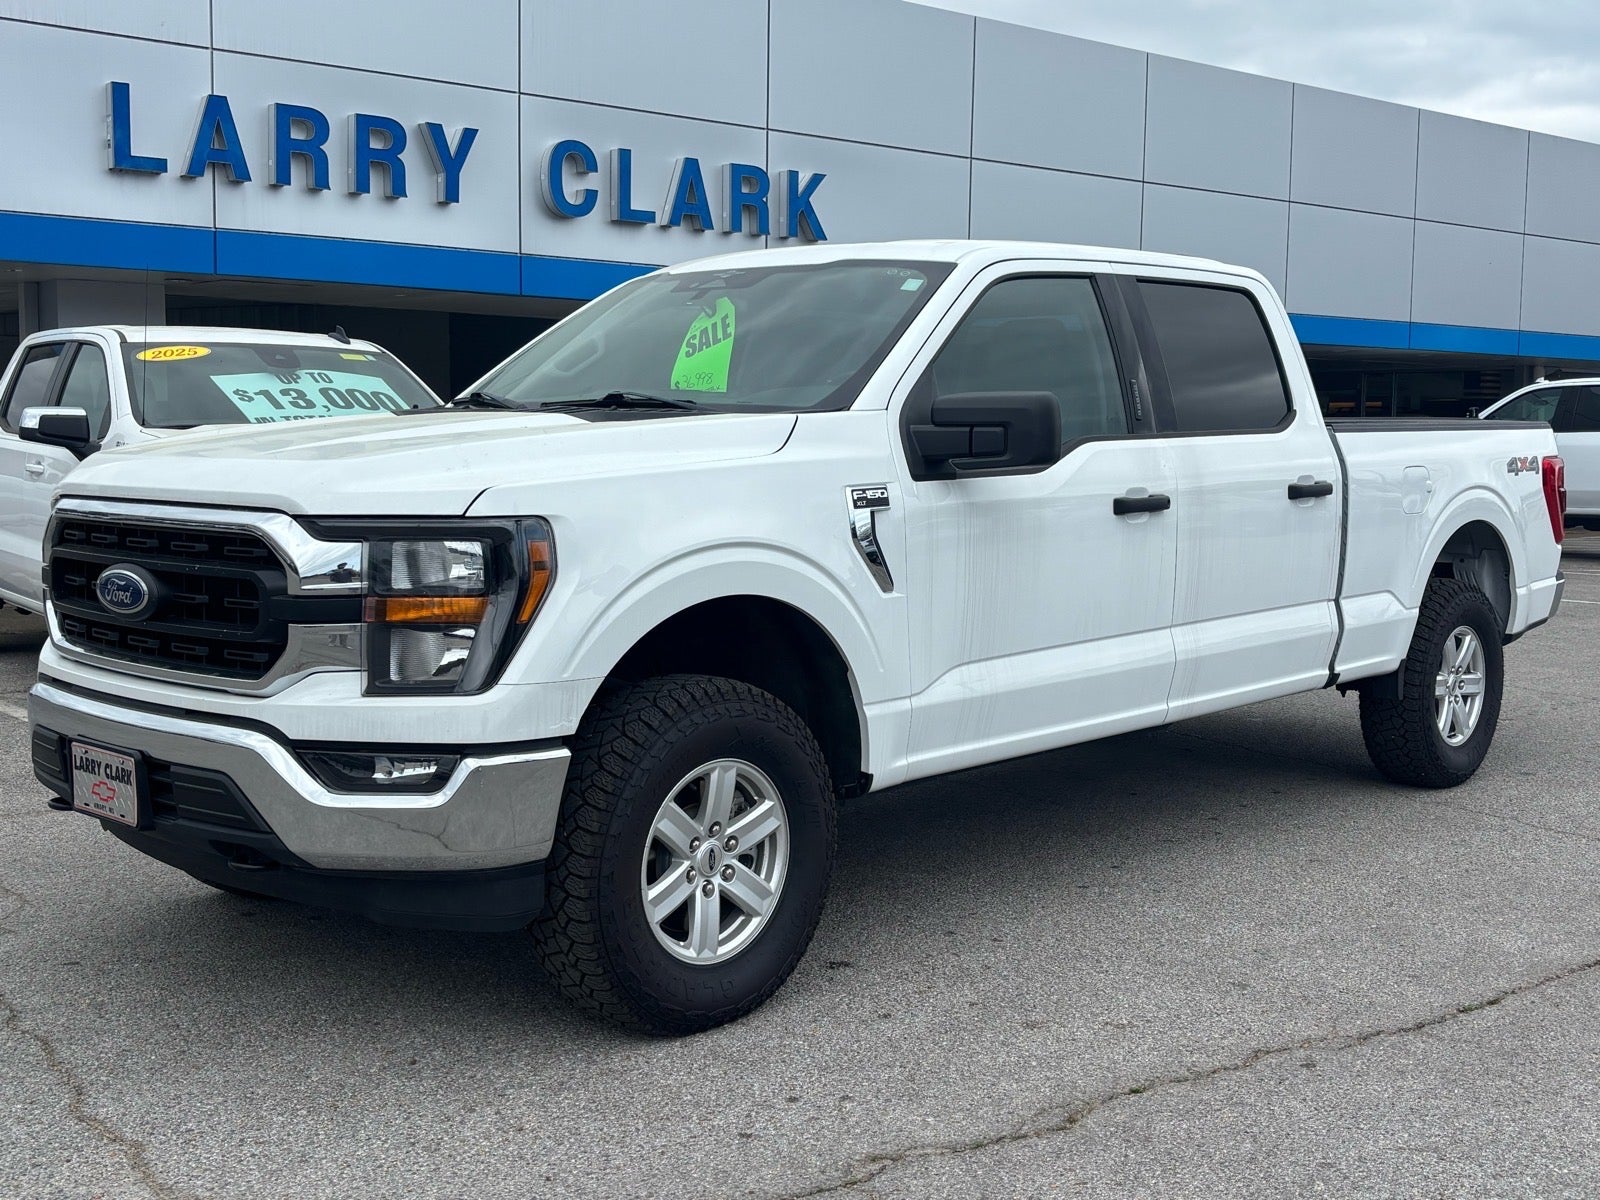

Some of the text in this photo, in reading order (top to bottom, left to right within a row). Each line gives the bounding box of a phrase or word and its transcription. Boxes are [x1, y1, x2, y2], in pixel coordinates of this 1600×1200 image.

[106, 81, 828, 242] LARRY CLARK
[685, 313, 732, 358] SALE
[152, 347, 198, 359] 2025
[275, 372, 334, 385] UP TO
[232, 387, 404, 413] $13,000
[852, 489, 888, 500] F-150
[105, 578, 134, 604] Ford
[73, 754, 133, 786] LARRY CLARK
